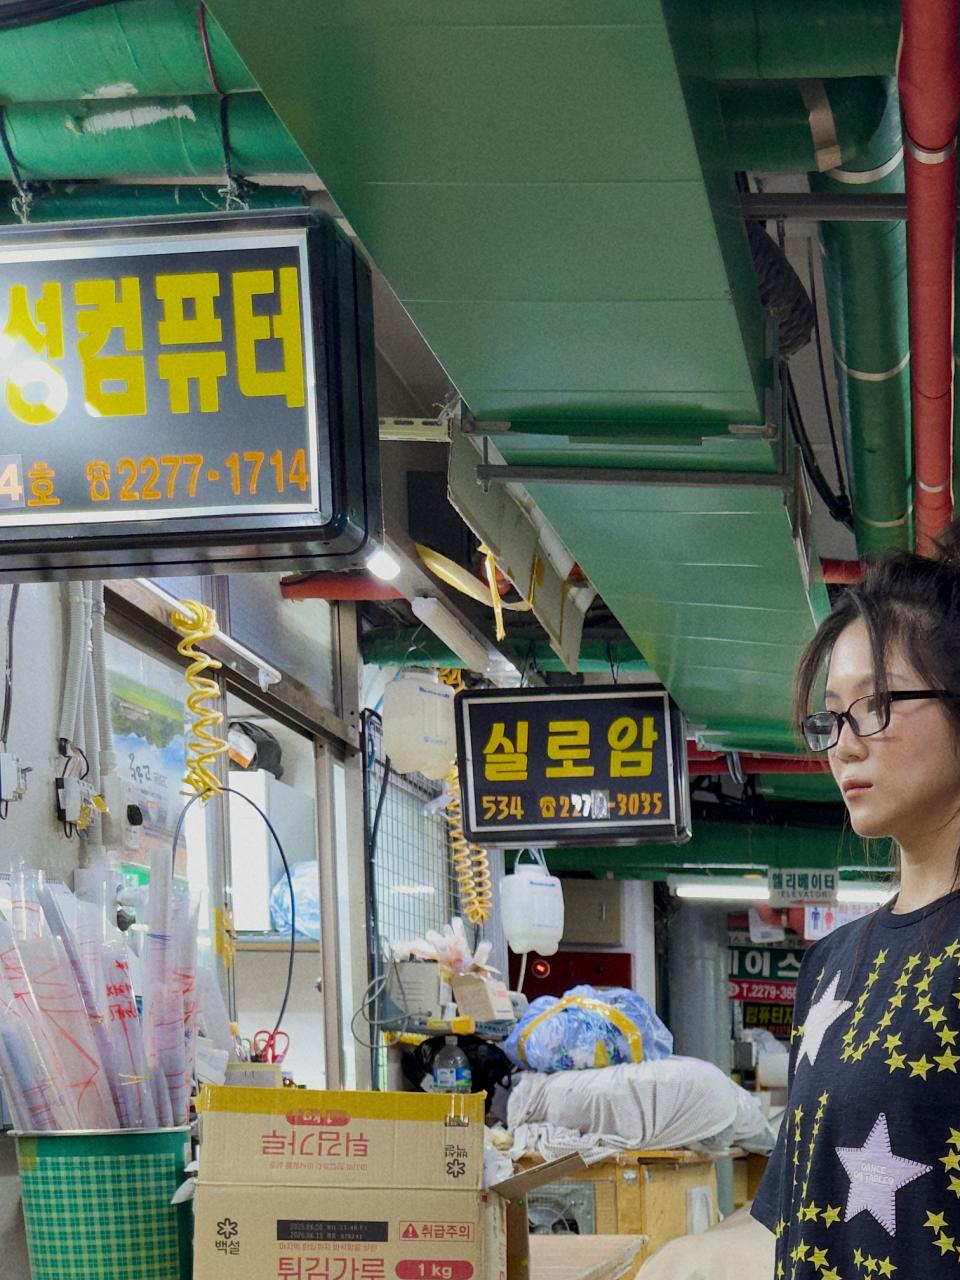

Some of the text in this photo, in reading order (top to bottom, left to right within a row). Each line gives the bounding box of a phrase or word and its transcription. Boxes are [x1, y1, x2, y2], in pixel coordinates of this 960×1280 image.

[483, 716, 659, 782] 실로암
[481, 795, 525, 820] 534
[771, 873, 836, 890] 엘리베이터
[261, 1129, 370, 1157] 튀김가루
[421, 1224, 471, 1239] 취급주의
[215, 1240, 240, 1255] 백설
[418, 1263, 453, 1280] 1 kg
